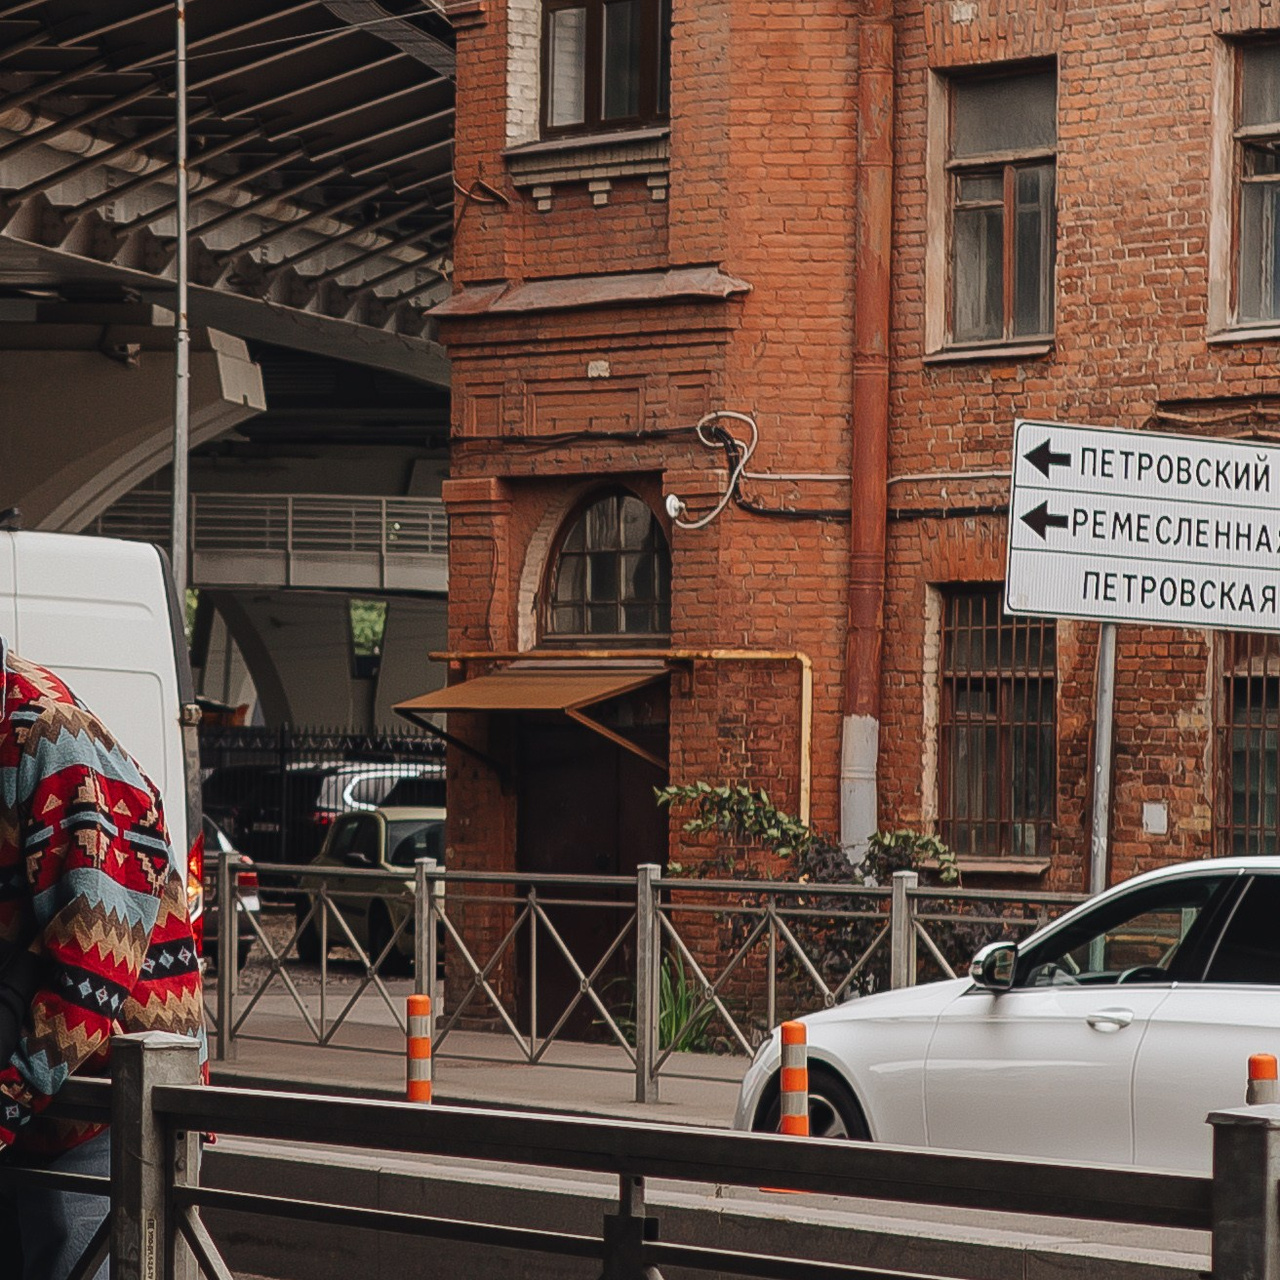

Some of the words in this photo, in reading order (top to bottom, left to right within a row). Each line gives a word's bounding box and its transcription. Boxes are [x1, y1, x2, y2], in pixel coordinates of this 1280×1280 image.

[1081, 447, 1270, 492] ПЕТРОВСКИЙ
[1073, 508, 1280, 553] РЕМЕСЛЕННА
[1083, 571, 1276, 613] ПЕТРОВСКАЯ
